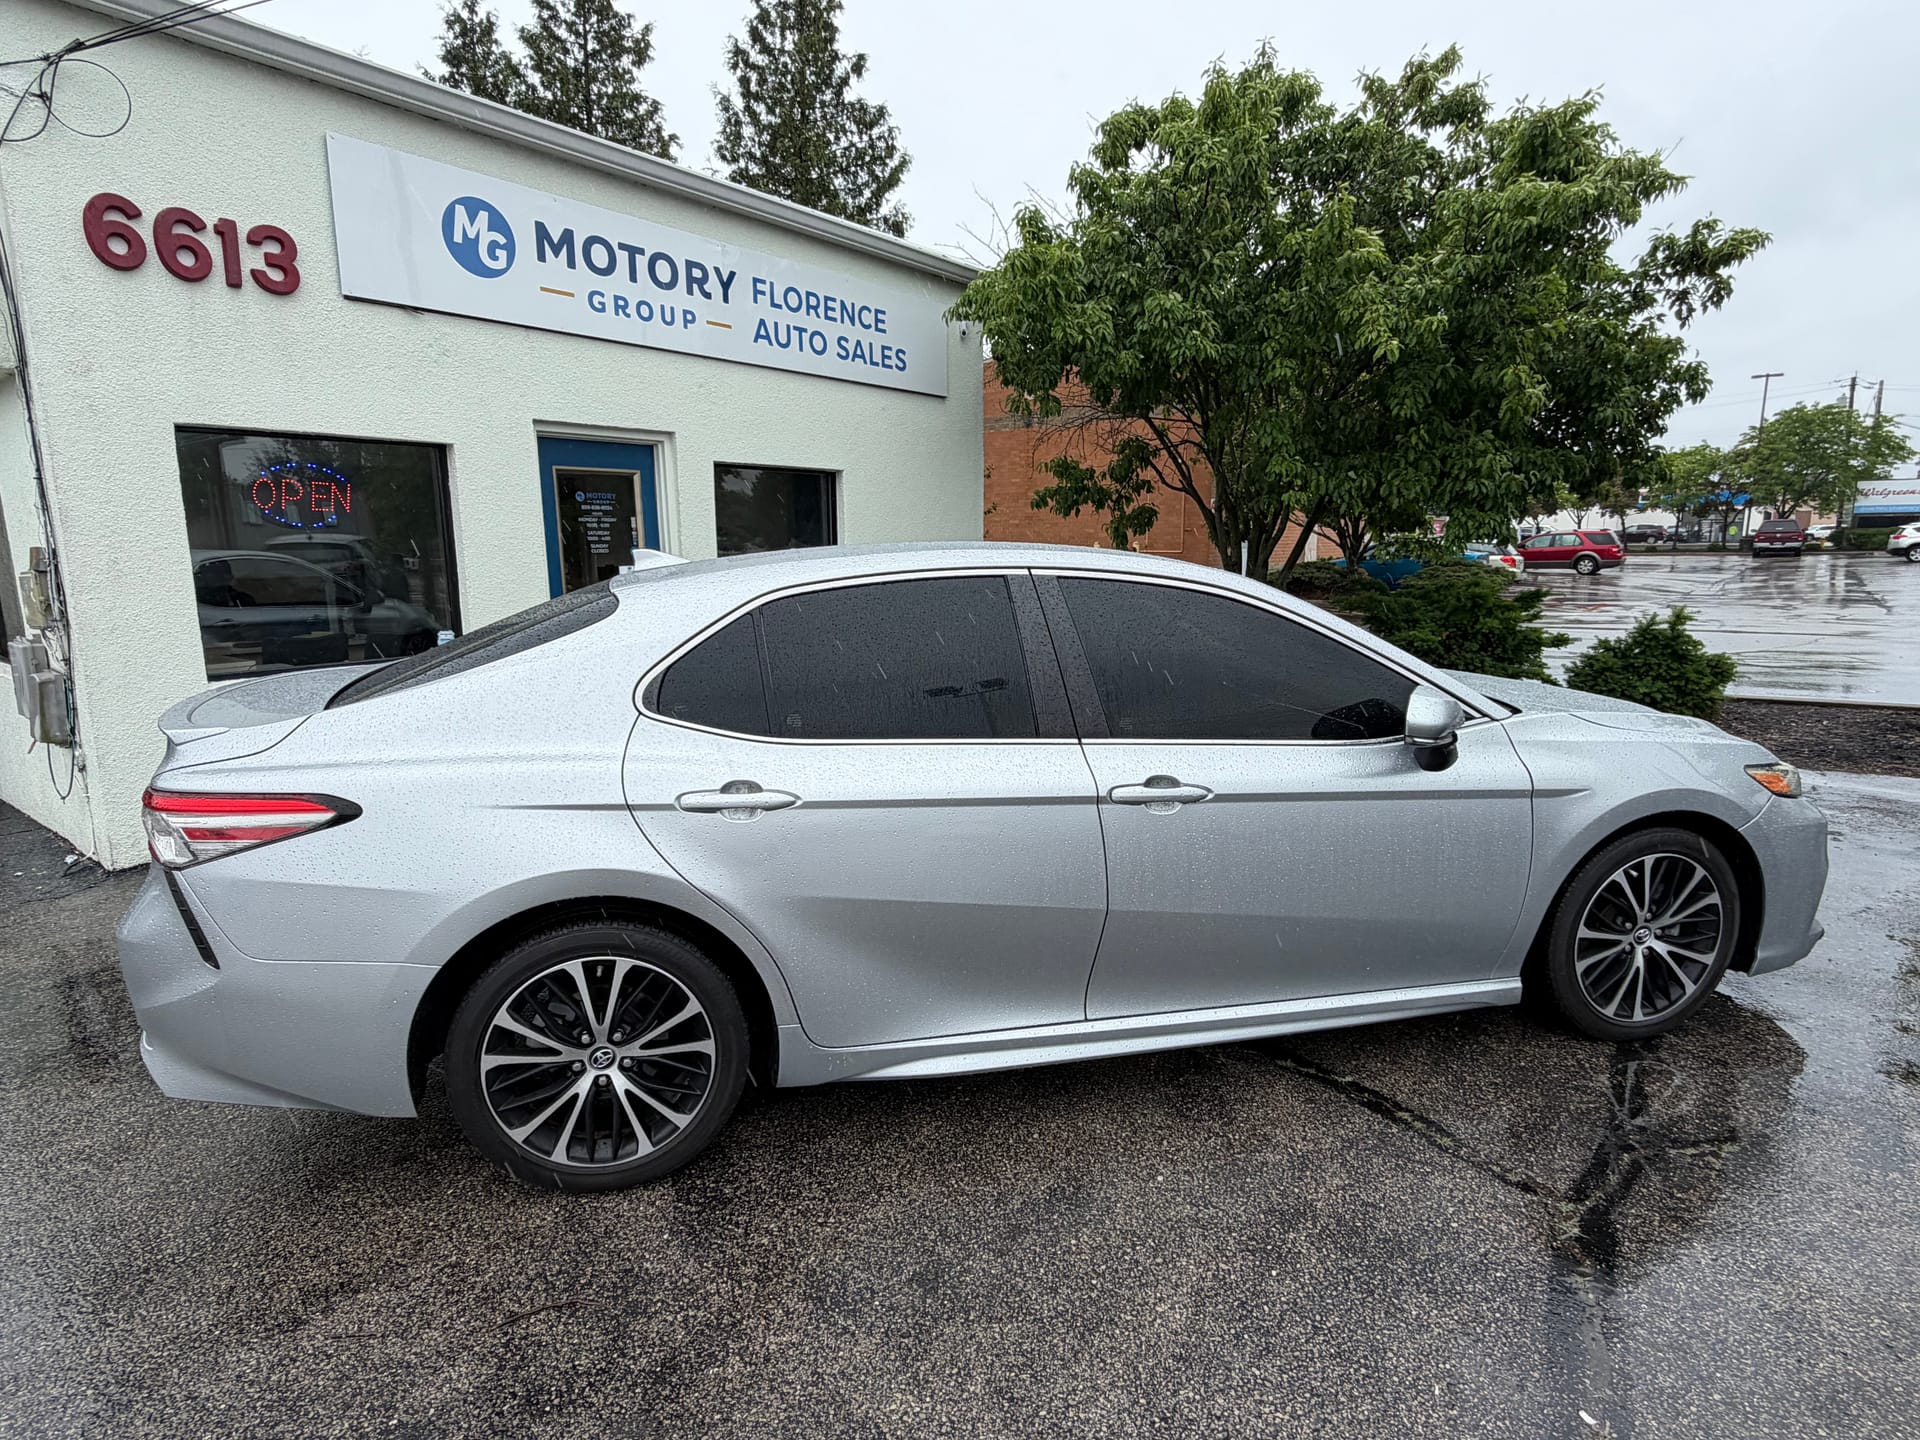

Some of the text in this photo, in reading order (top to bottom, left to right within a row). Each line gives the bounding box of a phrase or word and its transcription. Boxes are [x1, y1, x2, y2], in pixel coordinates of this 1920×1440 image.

[83, 192, 301, 295] 6613
[453, 204, 507, 269] MG
[534, 220, 736, 304] MOTORY
[587, 290, 697, 329] GROUP
[752, 276, 887, 334] FLORENCE
[753, 318, 907, 372] AUTO SALES
[252, 477, 351, 513] OPEN
